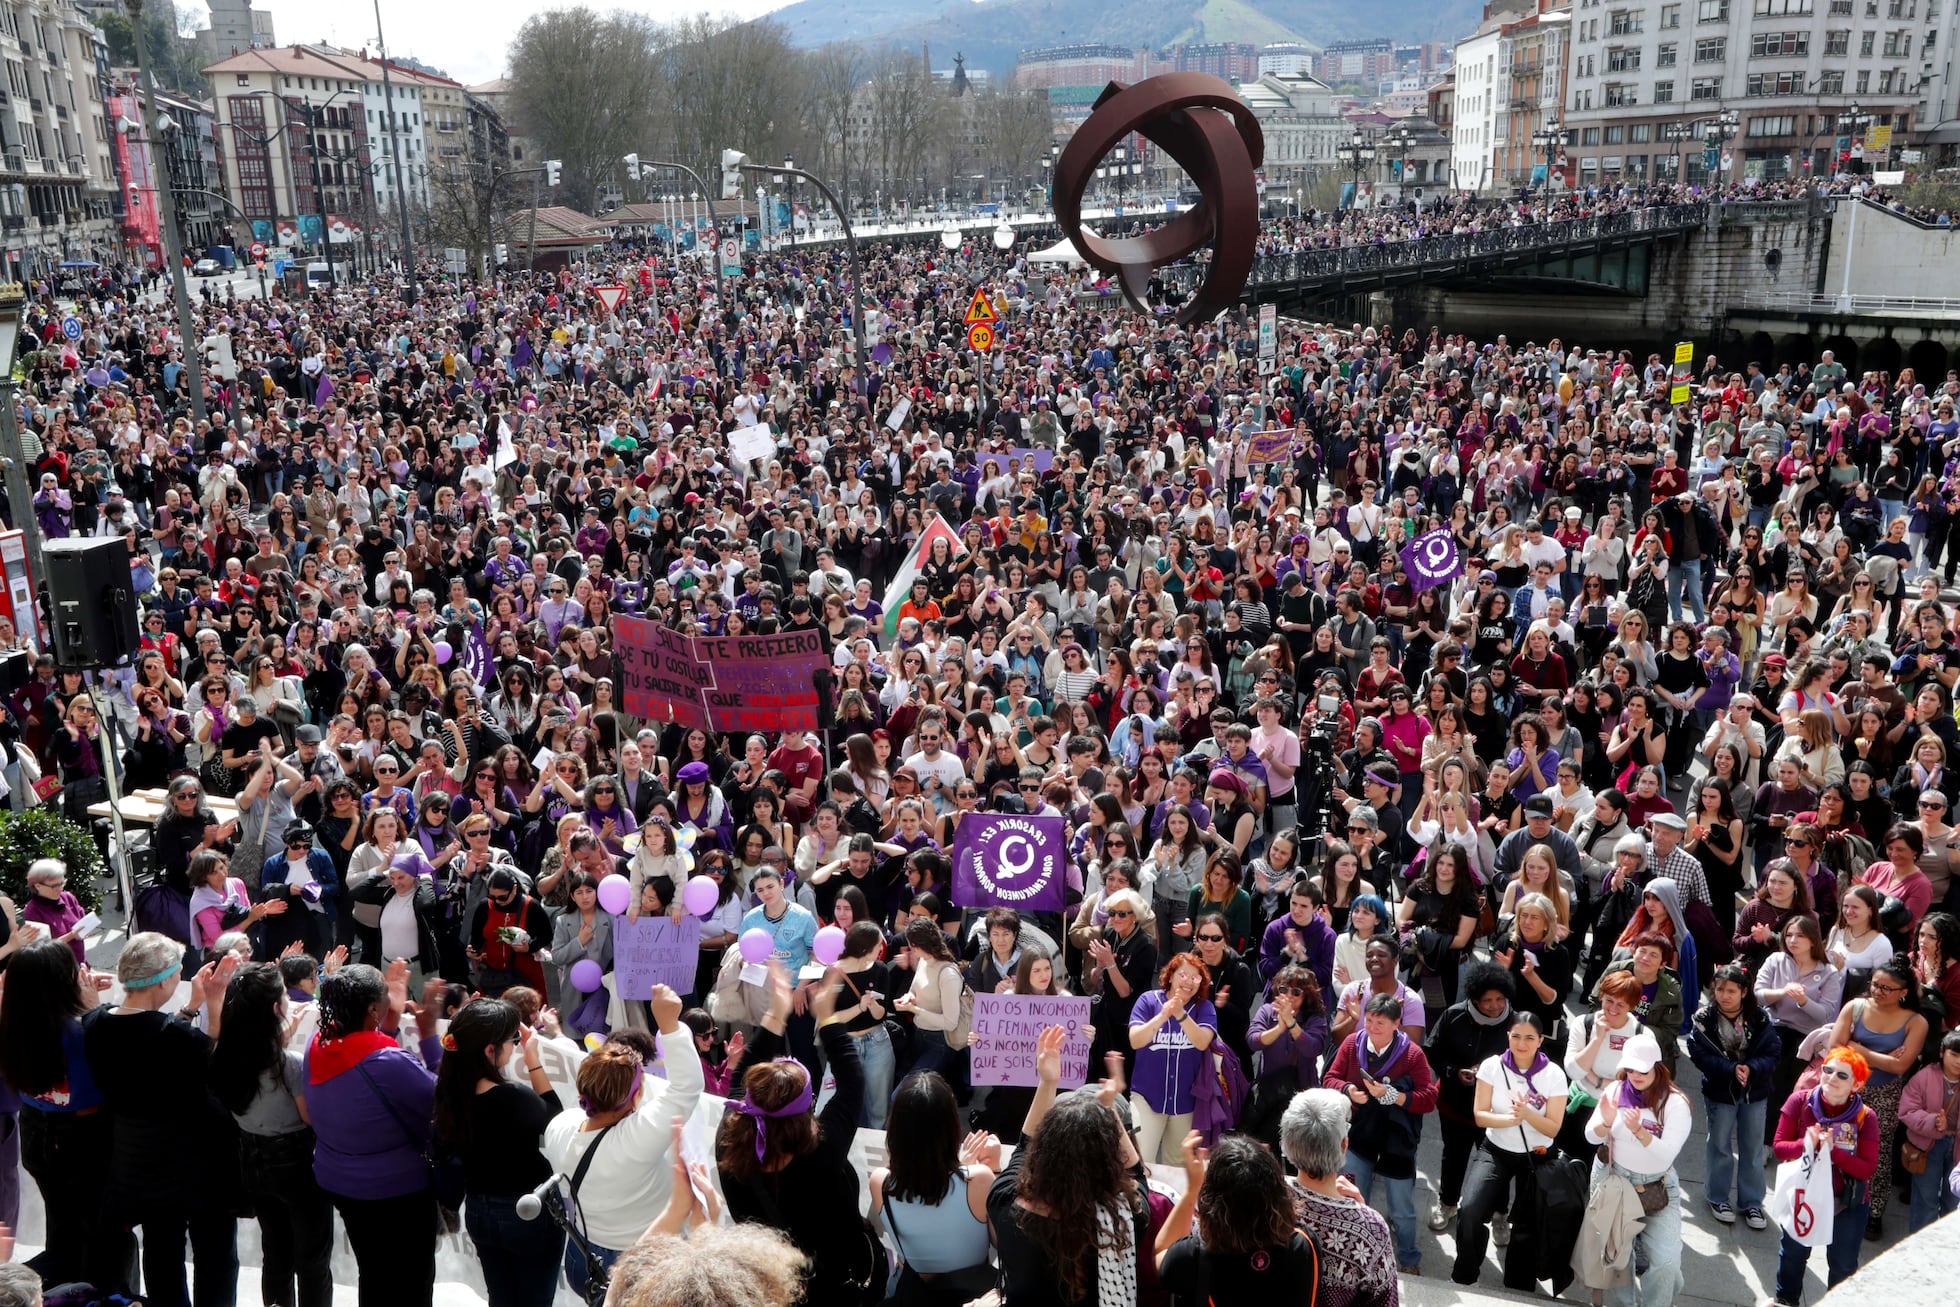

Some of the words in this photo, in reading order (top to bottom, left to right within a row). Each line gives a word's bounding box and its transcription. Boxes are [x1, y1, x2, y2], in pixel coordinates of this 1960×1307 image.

[974, 333, 988, 343] 30
[618, 621, 645, 646] NO
[655, 625, 688, 658] SALI
[702, 639, 731, 659] TE
[738, 633, 819, 658] PREFIERO
[619, 645, 634, 663] DE
[641, 644, 659, 669] TÚ
[645, 677, 683, 699] SALISTE
[684, 685, 699, 703] DE
[711, 693, 743, 707] QUE
[747, 690, 820, 707] VIOLADA
[719, 709, 733, 728] Y
[740, 710, 816, 729] MUERTA
[981, 1000, 999, 1015] NO
[1004, 1001, 1022, 1016] OS
[1029, 1003, 1088, 1017] INCOMODA
[977, 1020, 990, 1034] EL
[997, 1020, 1052, 1037] FEMINIS
[975, 1040, 990, 1050] OS
[995, 1040, 1037, 1053] INCOMO
[1059, 1042, 1089, 1058] SABER
[974, 1056, 998, 1069] QUE
[1004, 1056, 1033, 1069] SOIS
